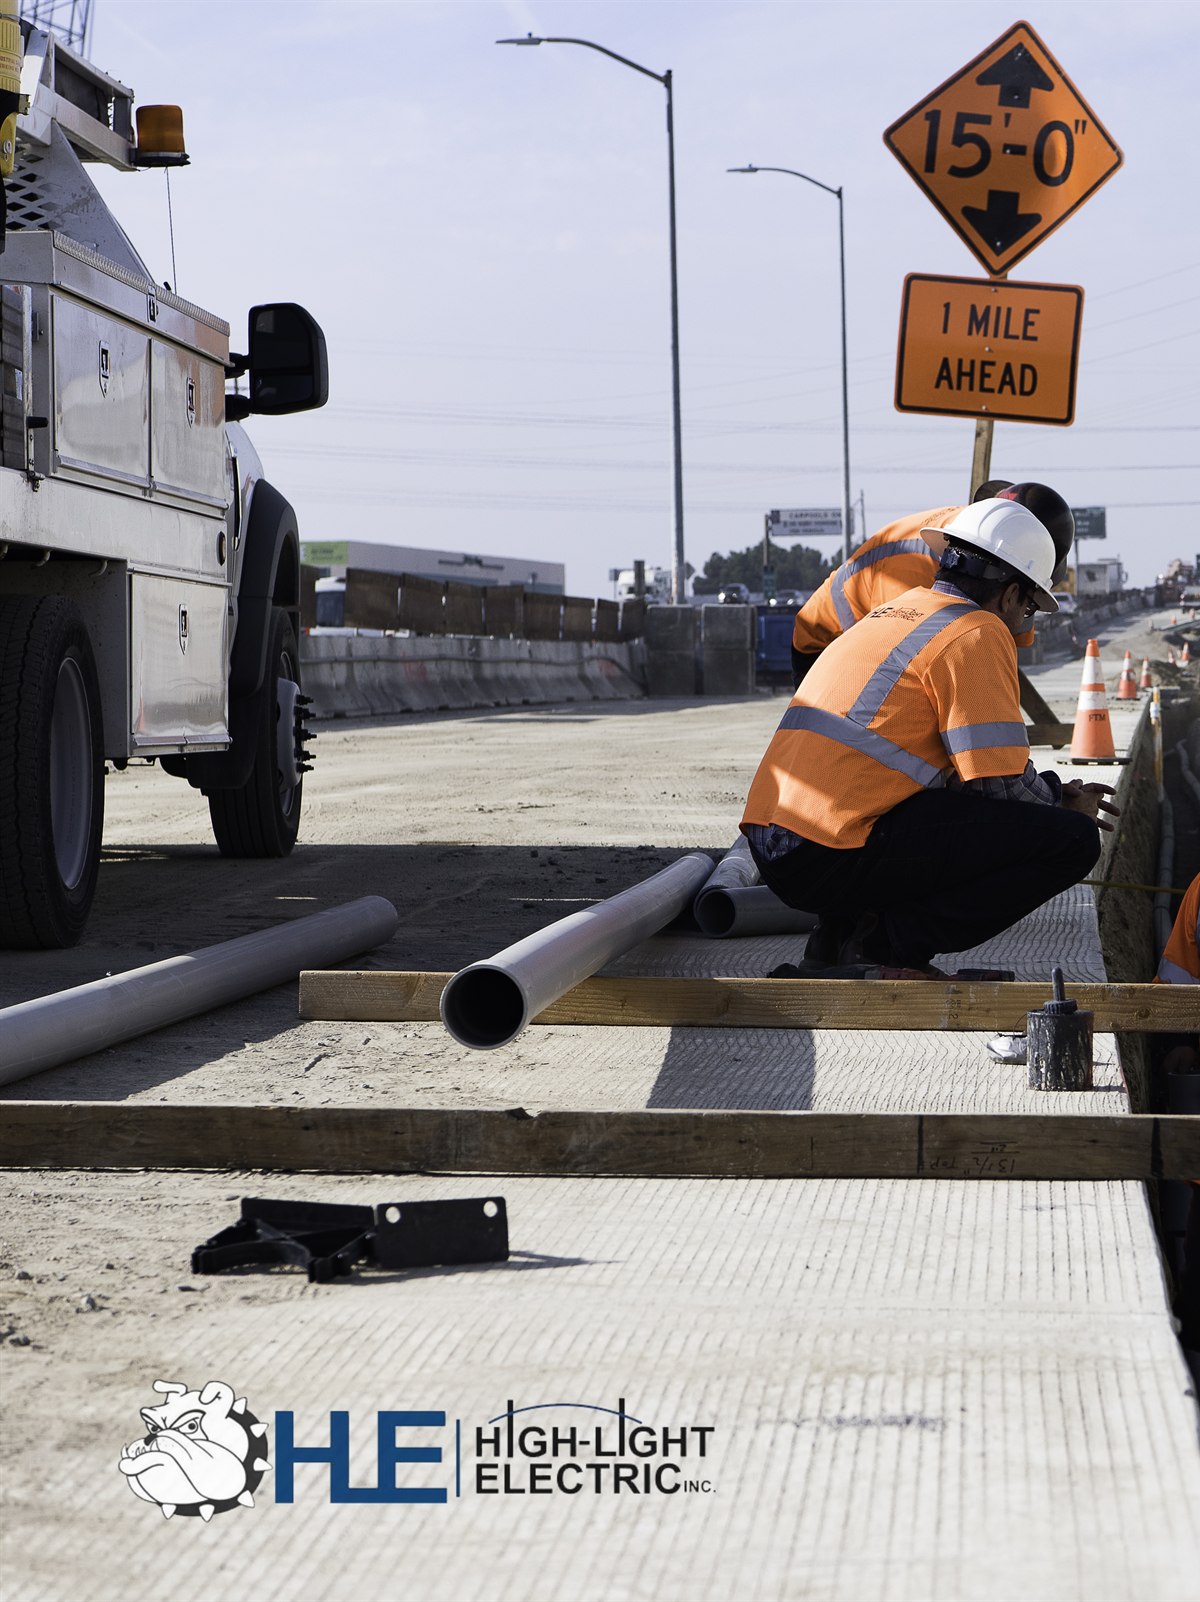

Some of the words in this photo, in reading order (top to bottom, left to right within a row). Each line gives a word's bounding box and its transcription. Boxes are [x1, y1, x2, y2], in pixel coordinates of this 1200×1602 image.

[942, 301, 951, 334] 1
[967, 304, 1040, 342] MILE
[934, 357, 1038, 397] AHEAD
